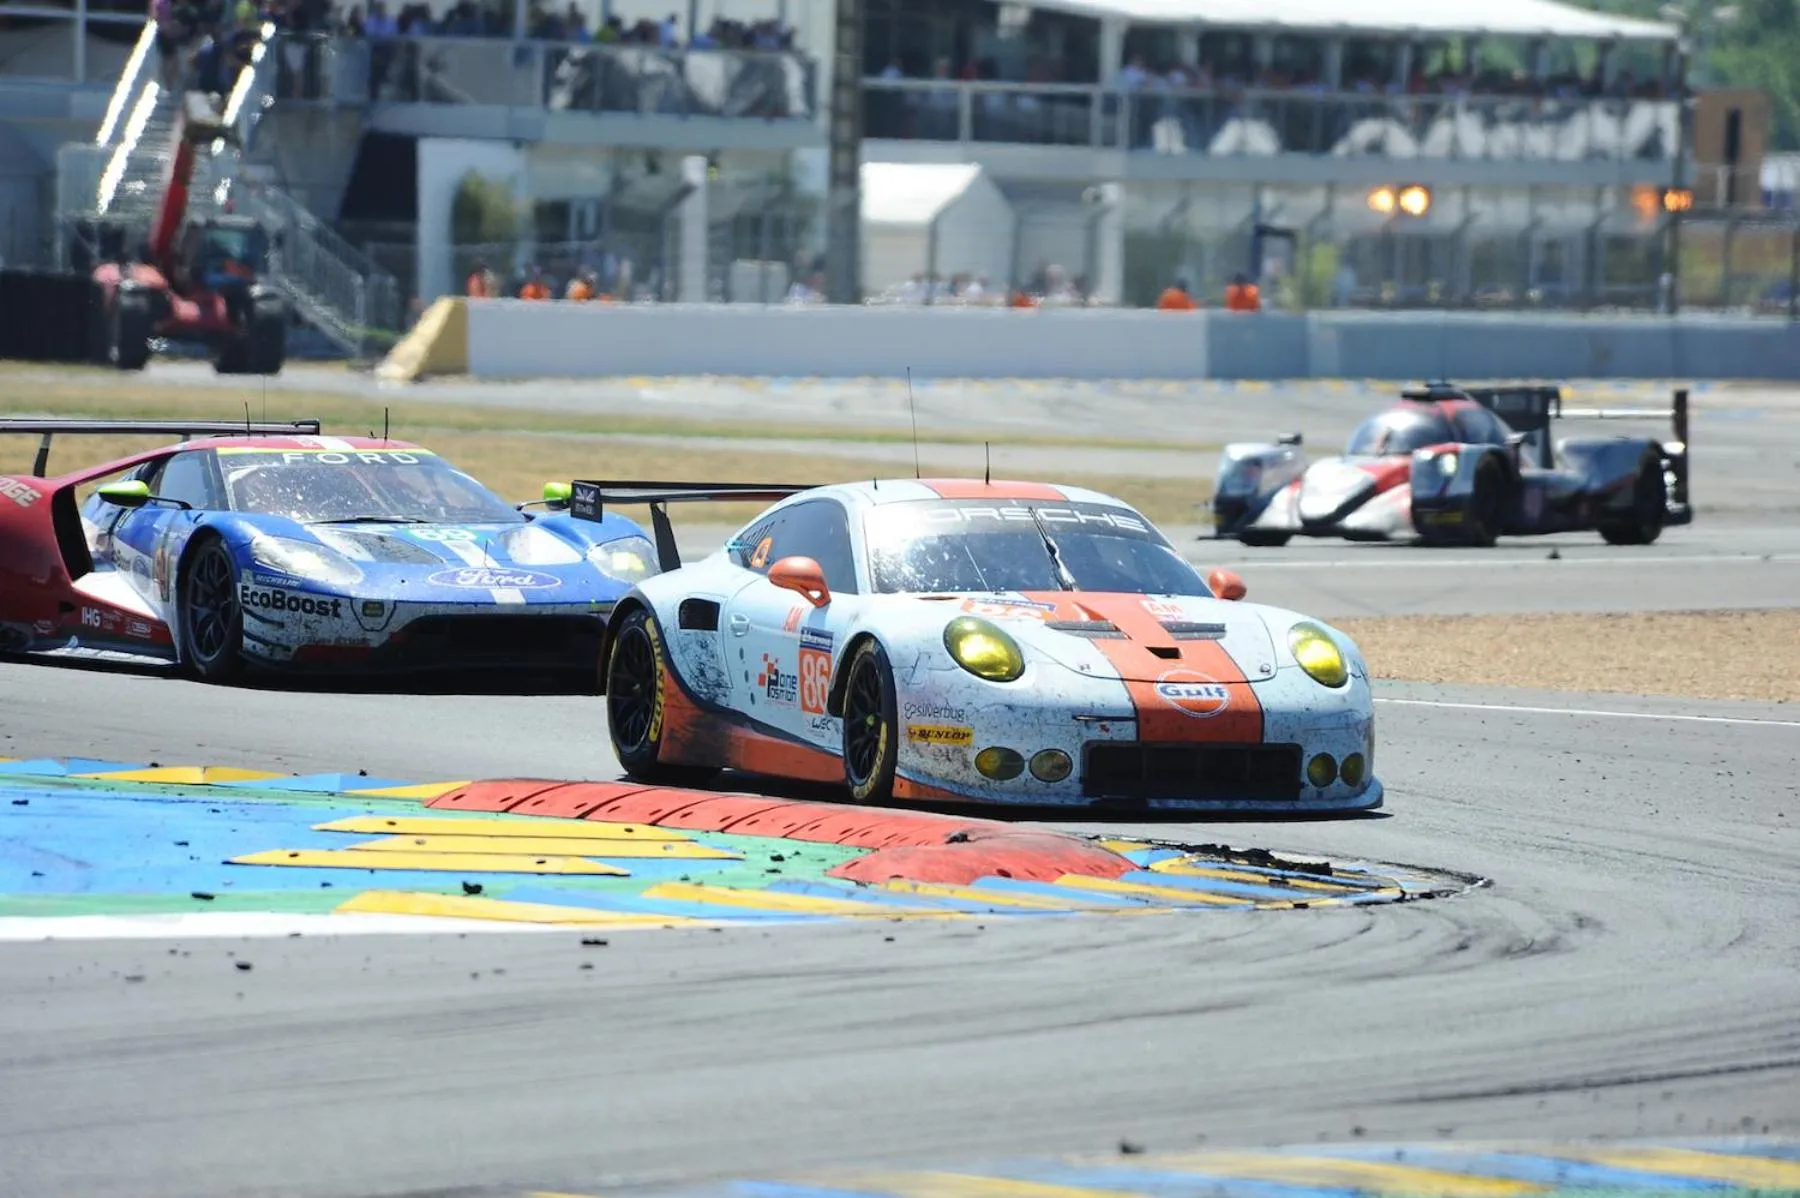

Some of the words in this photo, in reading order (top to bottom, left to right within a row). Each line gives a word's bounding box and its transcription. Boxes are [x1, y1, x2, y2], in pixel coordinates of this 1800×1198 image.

[282, 452, 419, 465] FORD
[924, 507, 1149, 533] ORSCHE
[455, 568, 537, 586] Ford
[240, 585, 342, 618] EcoBoost
[81, 606, 102, 627] IHG
[802, 654, 829, 709] 86
[1159, 684, 1226, 698] Gulf
[918, 729, 970, 740] DUNLOP
